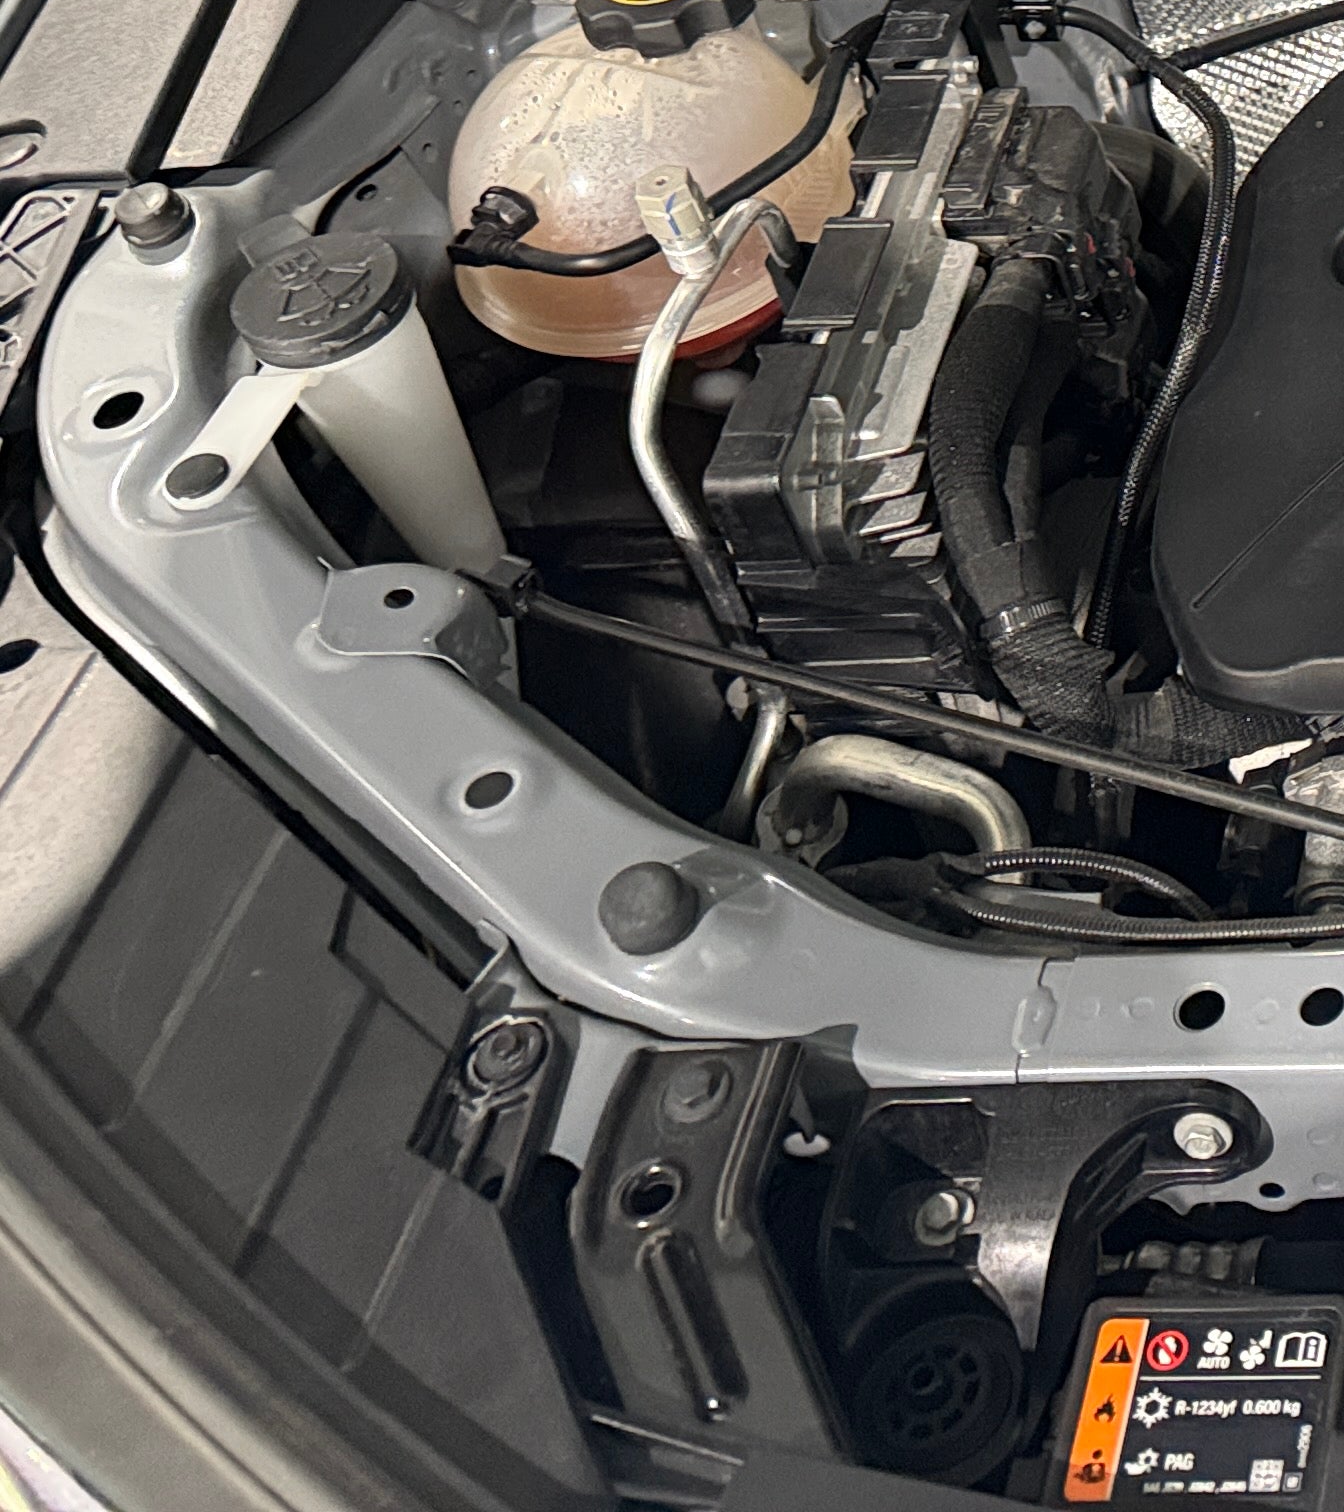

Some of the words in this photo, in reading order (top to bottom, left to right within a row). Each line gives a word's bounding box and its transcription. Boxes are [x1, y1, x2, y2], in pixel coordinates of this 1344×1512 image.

[1196, 1356, 1231, 1369] AUTO
[1174, 1399, 1238, 1419] R-1234yf
[1242, 1398, 1282, 1415] 0.600
[1282, 1399, 1302, 1418] kg
[1163, 1452, 1195, 1472] PAG
